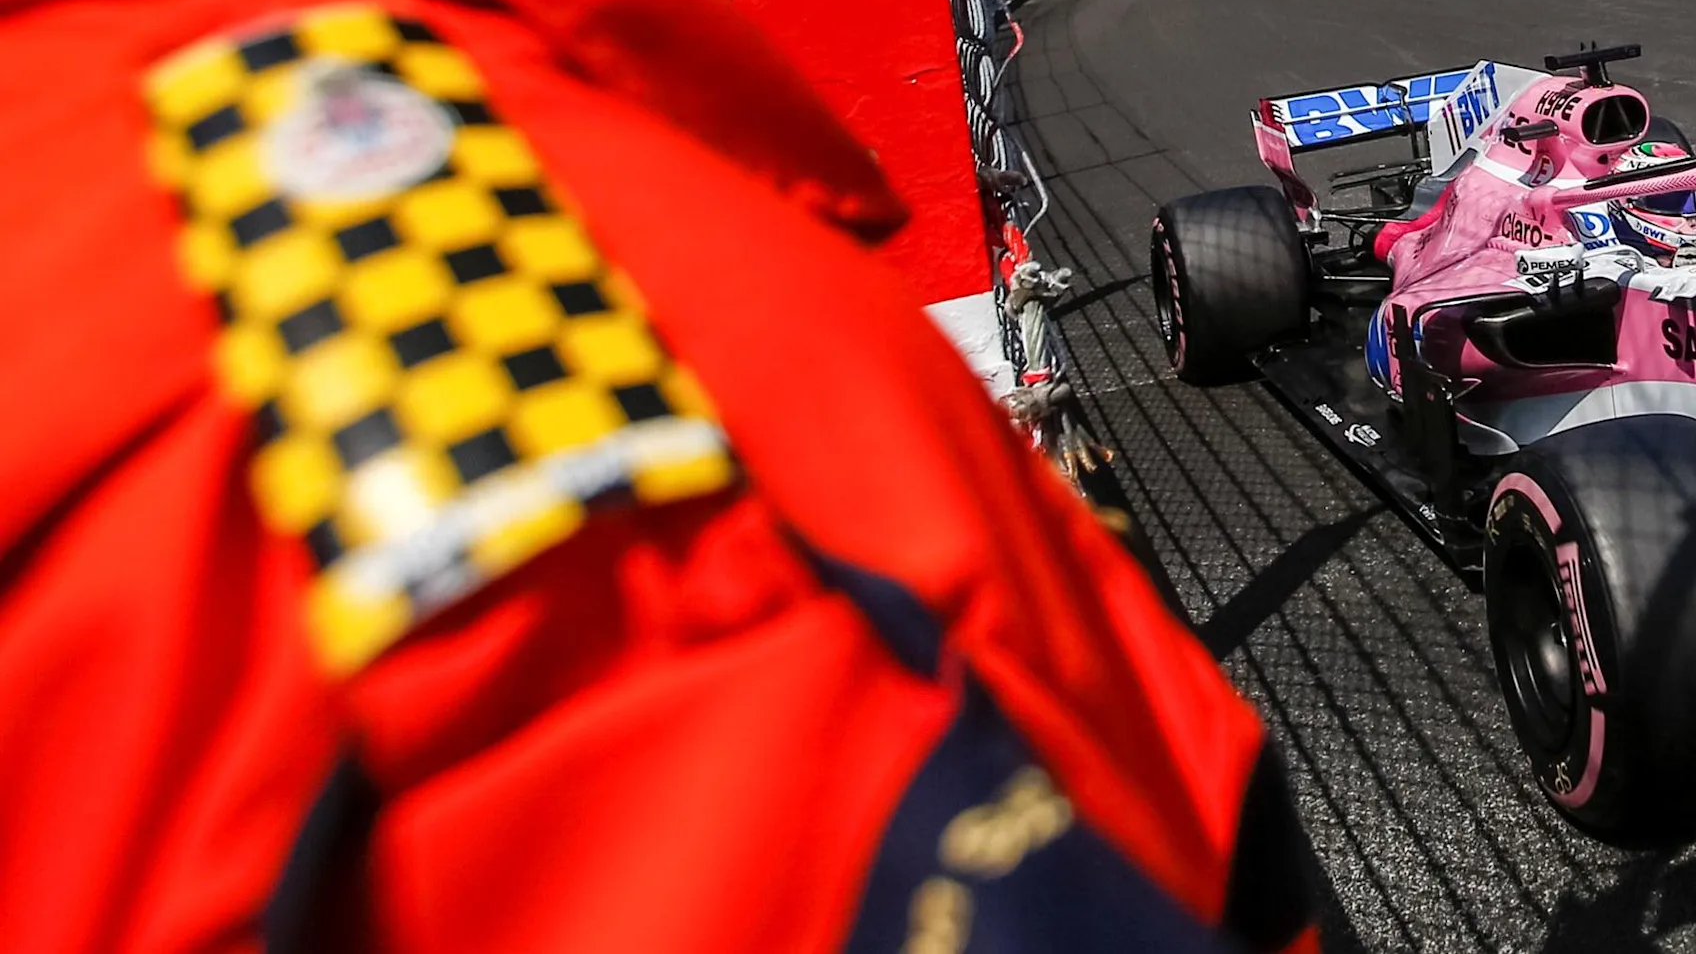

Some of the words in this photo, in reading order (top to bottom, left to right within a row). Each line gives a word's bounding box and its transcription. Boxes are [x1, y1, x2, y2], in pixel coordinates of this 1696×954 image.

[1457, 61, 1500, 139] BWT
[1535, 89, 1582, 122] HYPE
[1501, 213, 1543, 247] Claro
[1643, 226, 1666, 241] BWT
[1583, 237, 1618, 251] BWT
[1530, 258, 1576, 270] PEMEX
